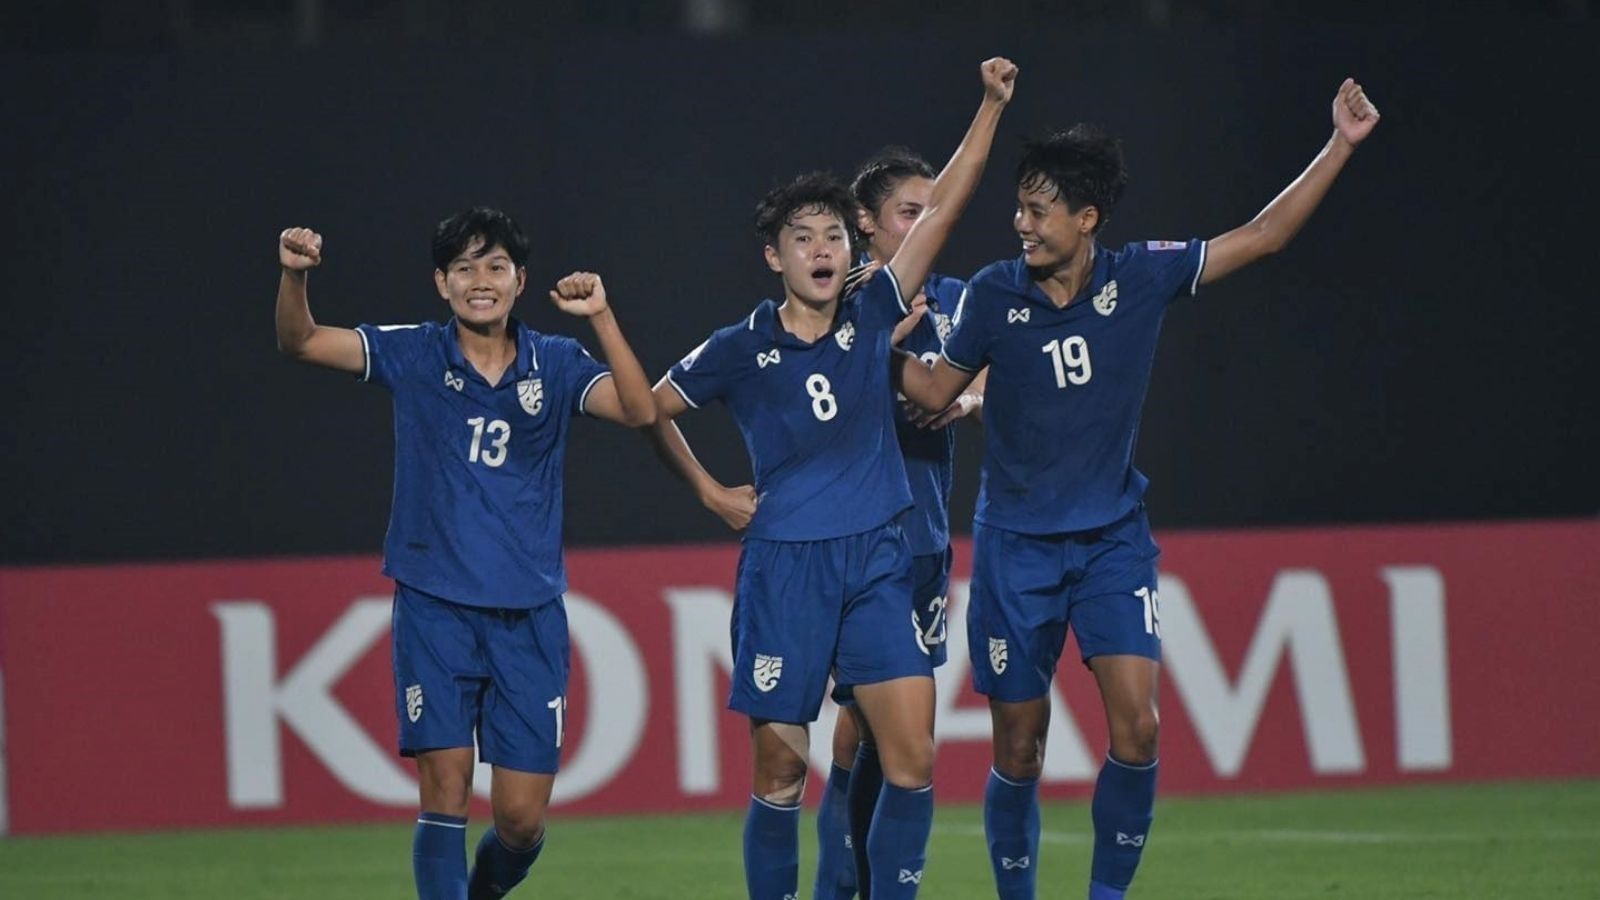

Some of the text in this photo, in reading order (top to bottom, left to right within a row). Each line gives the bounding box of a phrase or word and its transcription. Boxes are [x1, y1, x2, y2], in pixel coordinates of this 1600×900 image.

[1042, 336, 1092, 388] 19
[805, 373, 838, 422] 8
[467, 417, 510, 467] 13
[547, 696, 567, 748] 1
